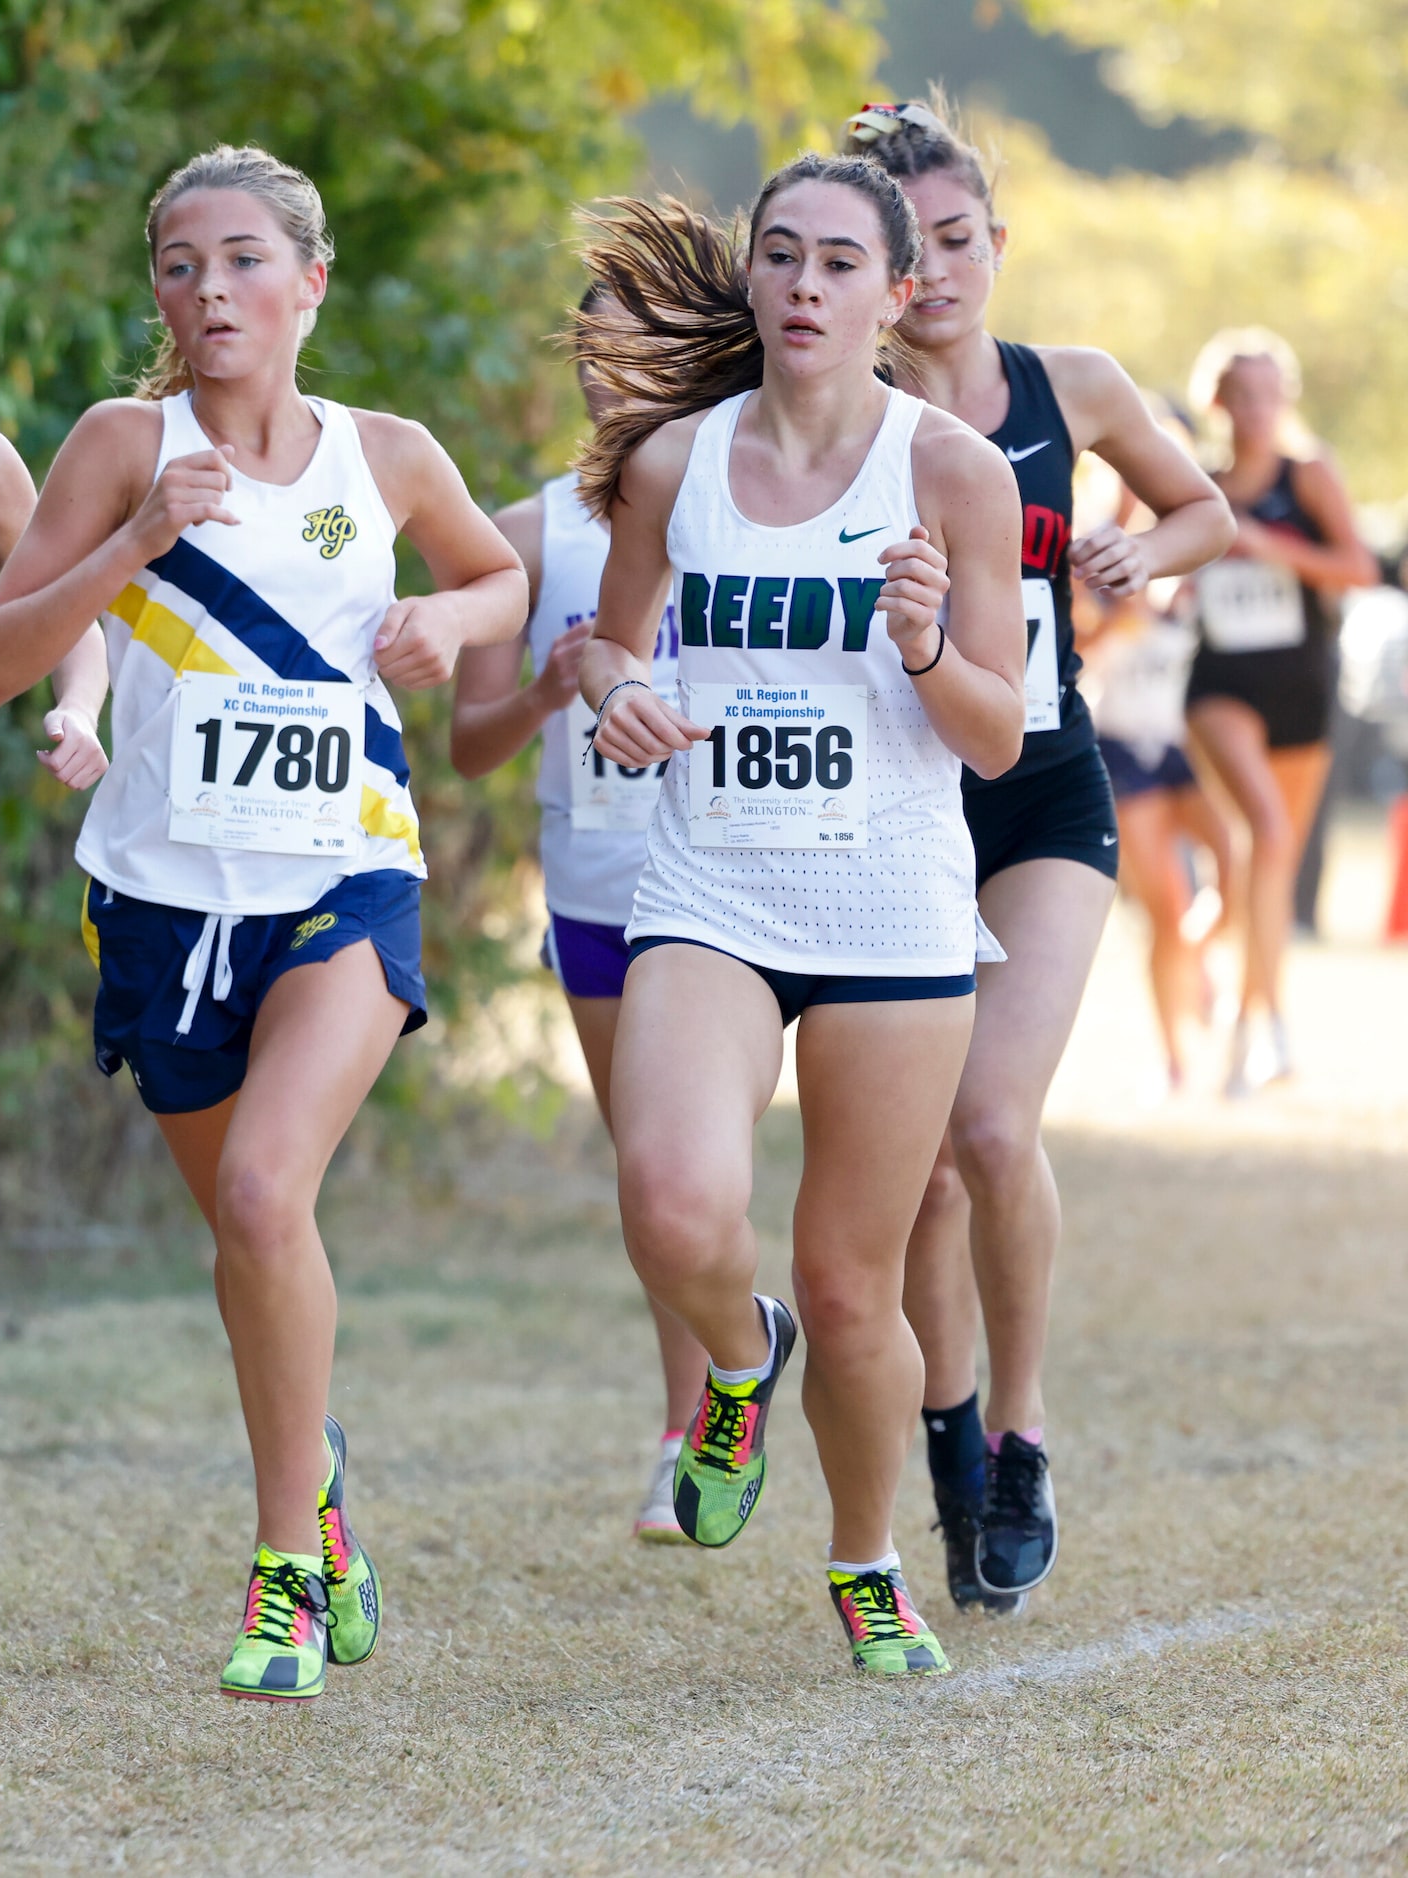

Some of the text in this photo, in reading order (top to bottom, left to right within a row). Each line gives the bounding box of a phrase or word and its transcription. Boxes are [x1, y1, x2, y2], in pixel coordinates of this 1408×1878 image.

[302, 505, 356, 559] HP
[681, 572, 887, 652] REEDY
[238, 682, 314, 698] UIL Region II
[736, 689, 808, 702] UIL Region II
[223, 698, 328, 719] XC Championship
[725, 706, 825, 720] XC Championship
[195, 718, 351, 793] 1780
[704, 725, 853, 790] 1856
[747, 796, 782, 806] University
[783, 796, 792, 804] of
[232, 805, 304, 819] ARLINGTON
[740, 806, 807, 816] ARLINGTON
[327, 839, 344, 848] 1780
[819, 832, 854, 841] No. 1856
